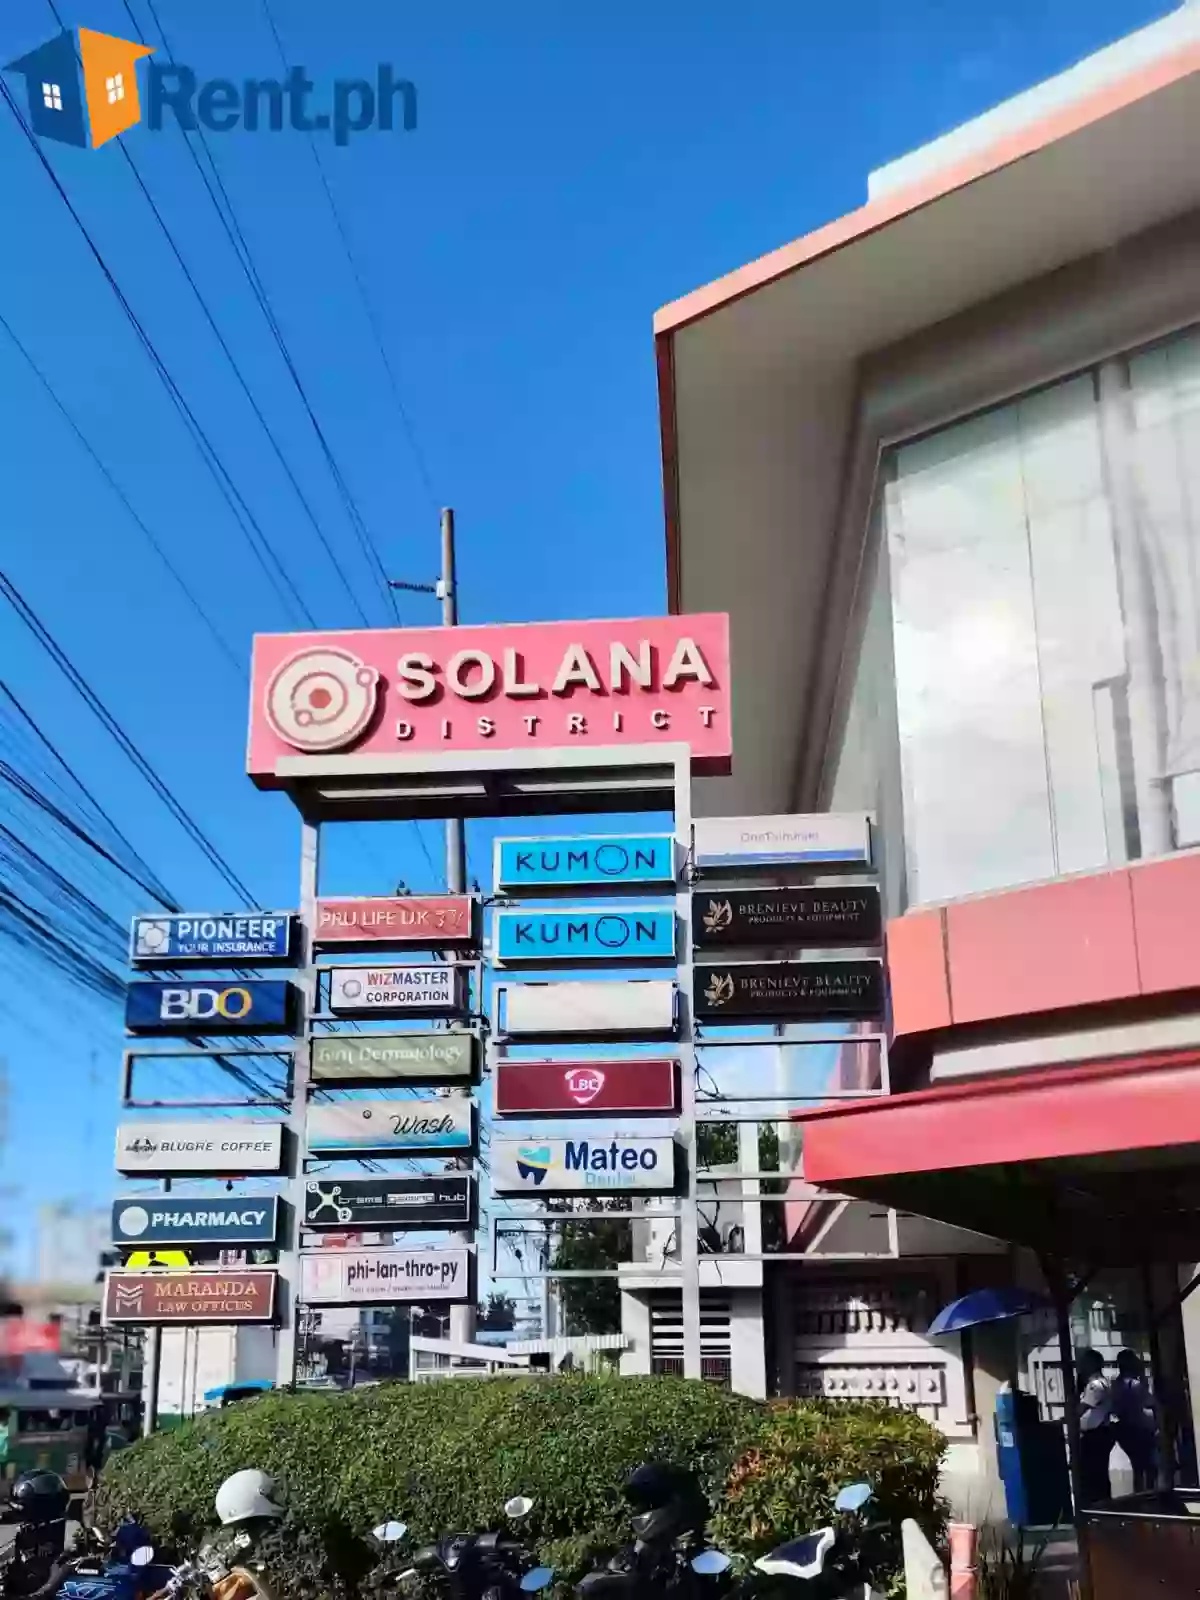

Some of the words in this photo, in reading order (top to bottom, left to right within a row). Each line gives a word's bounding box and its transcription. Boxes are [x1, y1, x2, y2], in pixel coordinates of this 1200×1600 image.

[396, 637, 714, 701] SOLANA
[395, 706, 717, 740] DISTRICT
[516, 844, 656, 875] KUMON
[813, 899, 868, 913] BEAUTY
[319, 910, 357, 927] PRU
[362, 911, 397, 926] LIFE
[177, 919, 278, 940] PIONEER
[515, 915, 656, 948] KUMON
[177, 942, 210, 953] YOUR
[213, 941, 276, 953] INSURANCE
[367, 971, 449, 986] WIZMASTER
[159, 987, 252, 1020] BDO
[366, 990, 449, 1002] CORPORATION
[569, 1079, 600, 1092] LBC
[389, 1113, 456, 1135] Wash
[220, 1141, 273, 1152] COFFEE
[564, 1140, 658, 1171] Mateo
[151, 1210, 267, 1228] PHARMACY
[347, 1258, 459, 1286] phi-lan-thro-py
[154, 1281, 259, 1298] MARANDA
[156, 1301, 190, 1313] LAW
[191, 1299, 254, 1312] OFFICES
